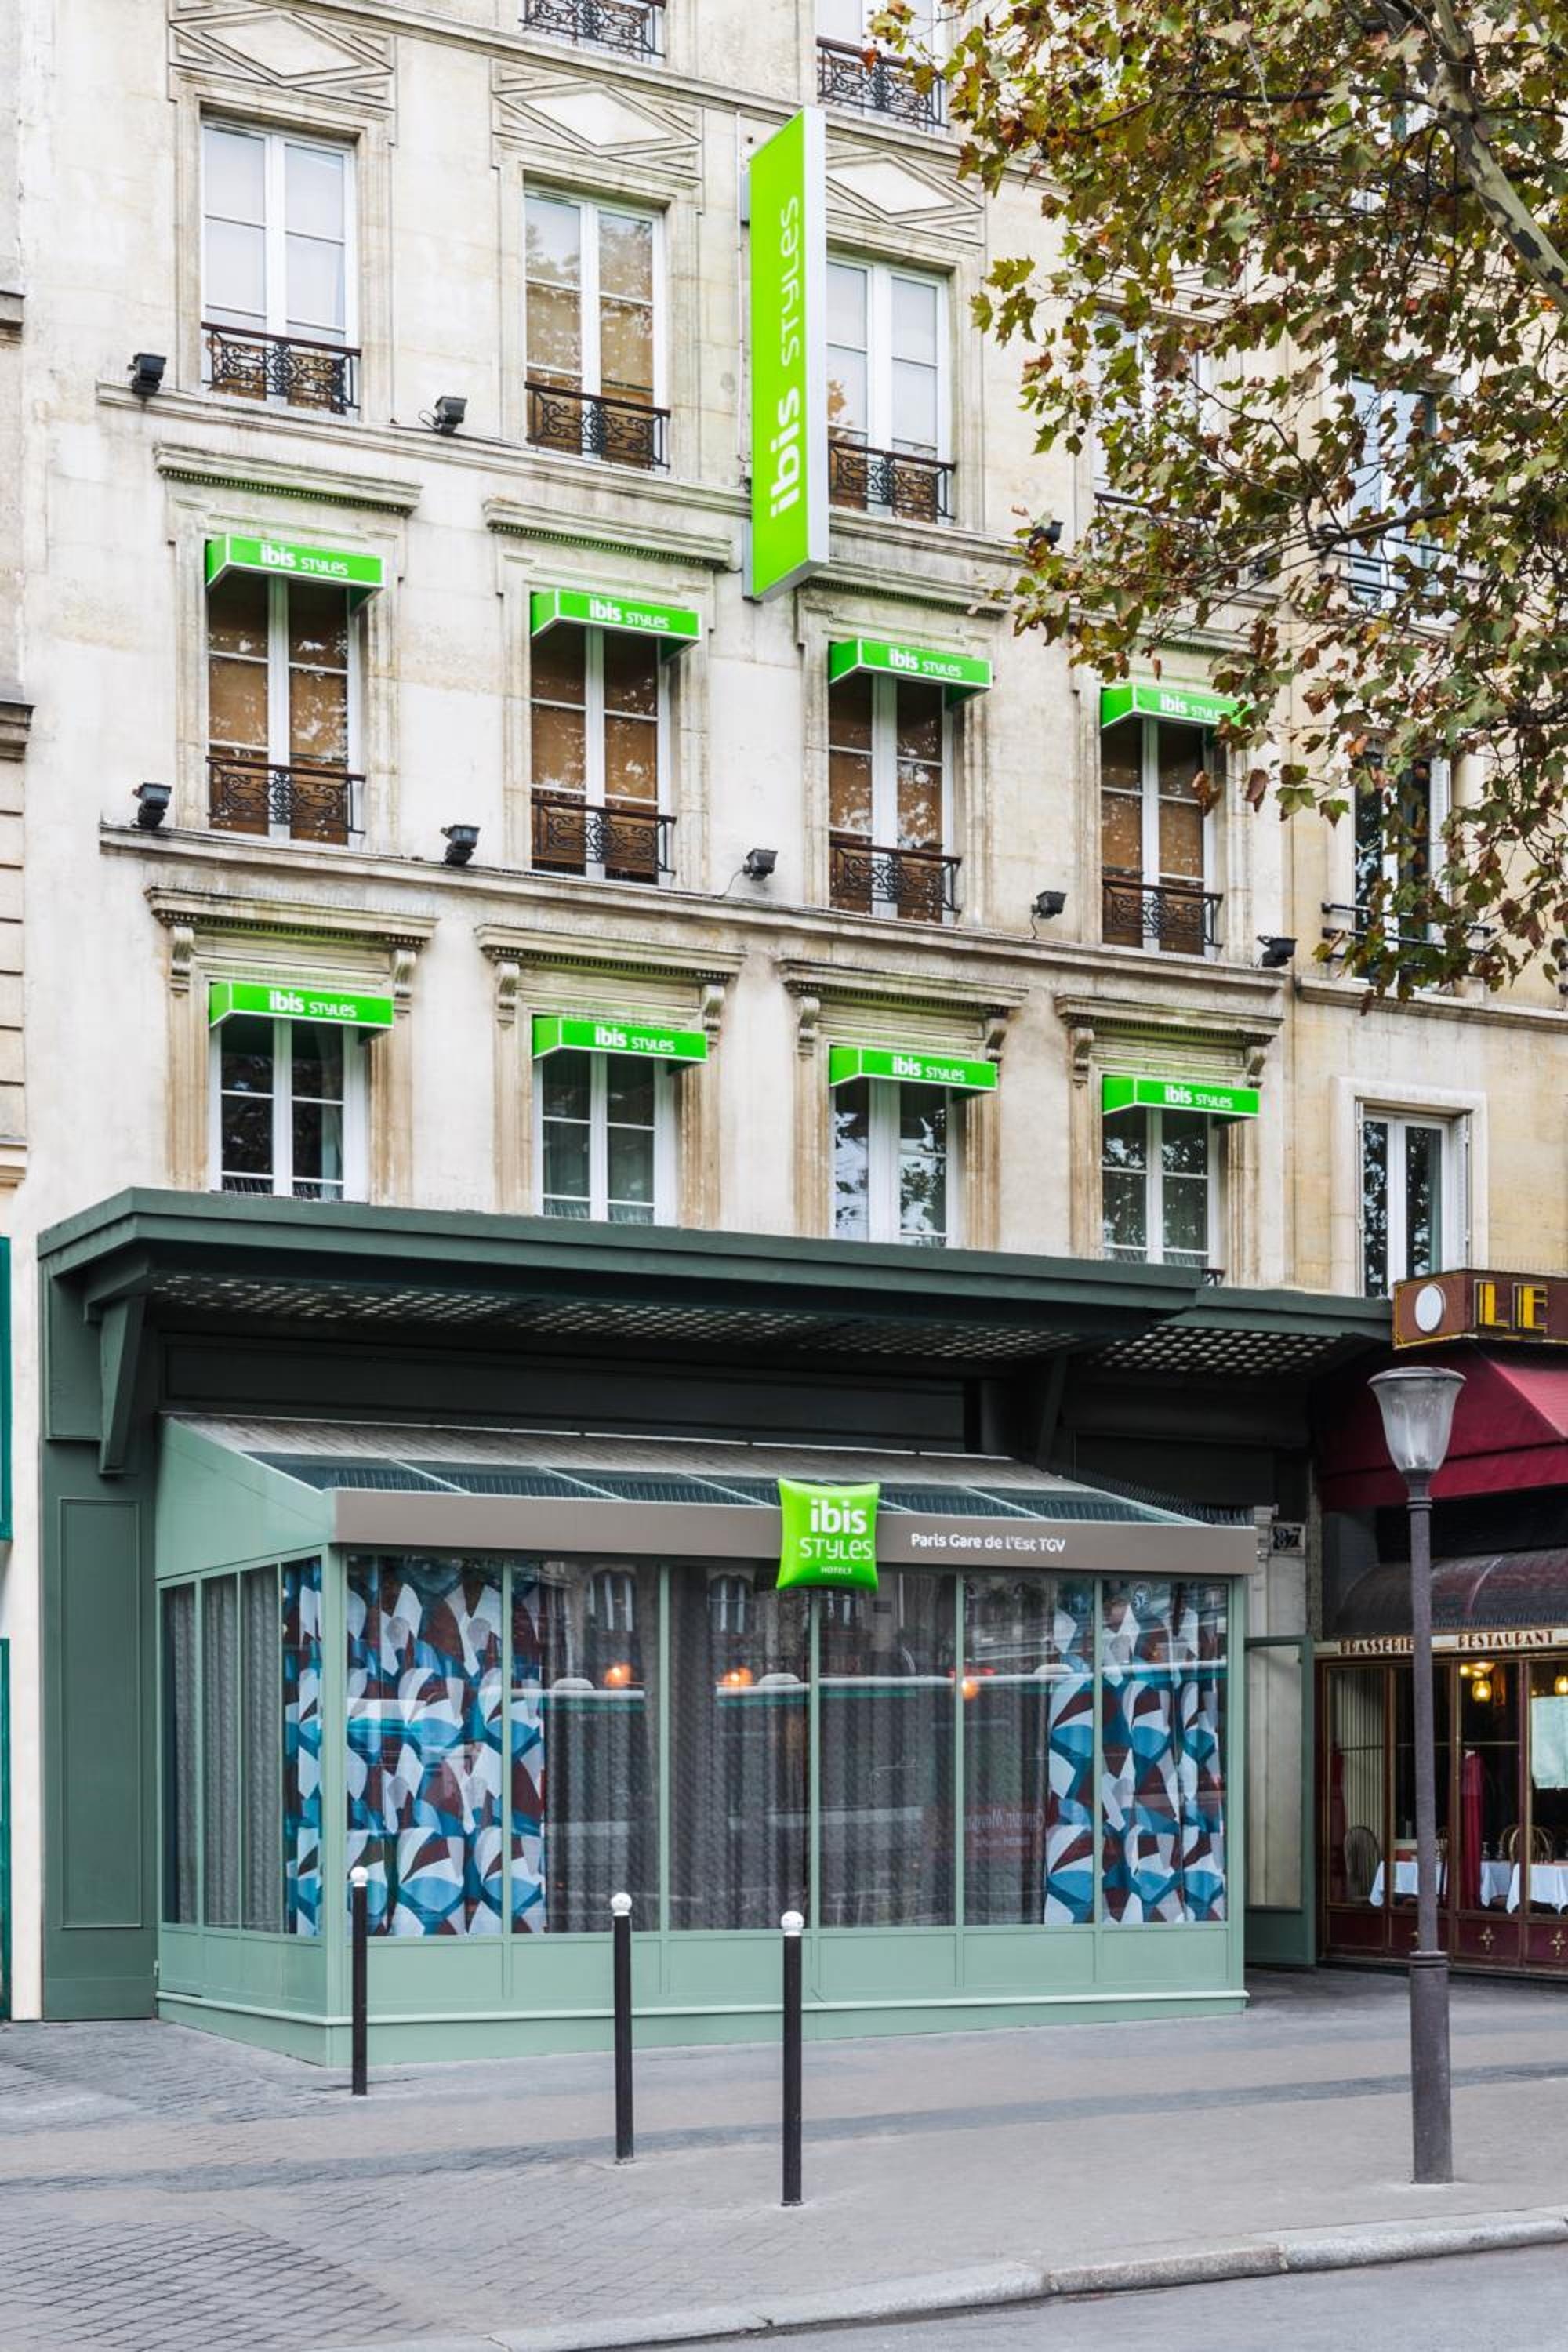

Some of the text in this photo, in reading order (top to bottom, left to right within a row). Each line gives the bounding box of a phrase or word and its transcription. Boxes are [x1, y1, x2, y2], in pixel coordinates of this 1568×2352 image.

[771, 387, 800, 517] ibis
[260, 543, 297, 568] ibis
[589, 598, 622, 623] ibis
[888, 647, 920, 671] ibis
[1160, 693, 1188, 714] ibis
[269, 990, 305, 1013] ibis
[595, 1025, 627, 1048] ibis
[892, 1055, 922, 1077] ibis
[1164, 1085, 1192, 1105] ibis
[1474, 1279, 1548, 1333] LE
[811, 1498, 867, 1534] ibis
[911, 1533, 1066, 1552] Paris Gare de l'Est TGV
[1457, 1631, 1553, 1648] RESTAURANT
